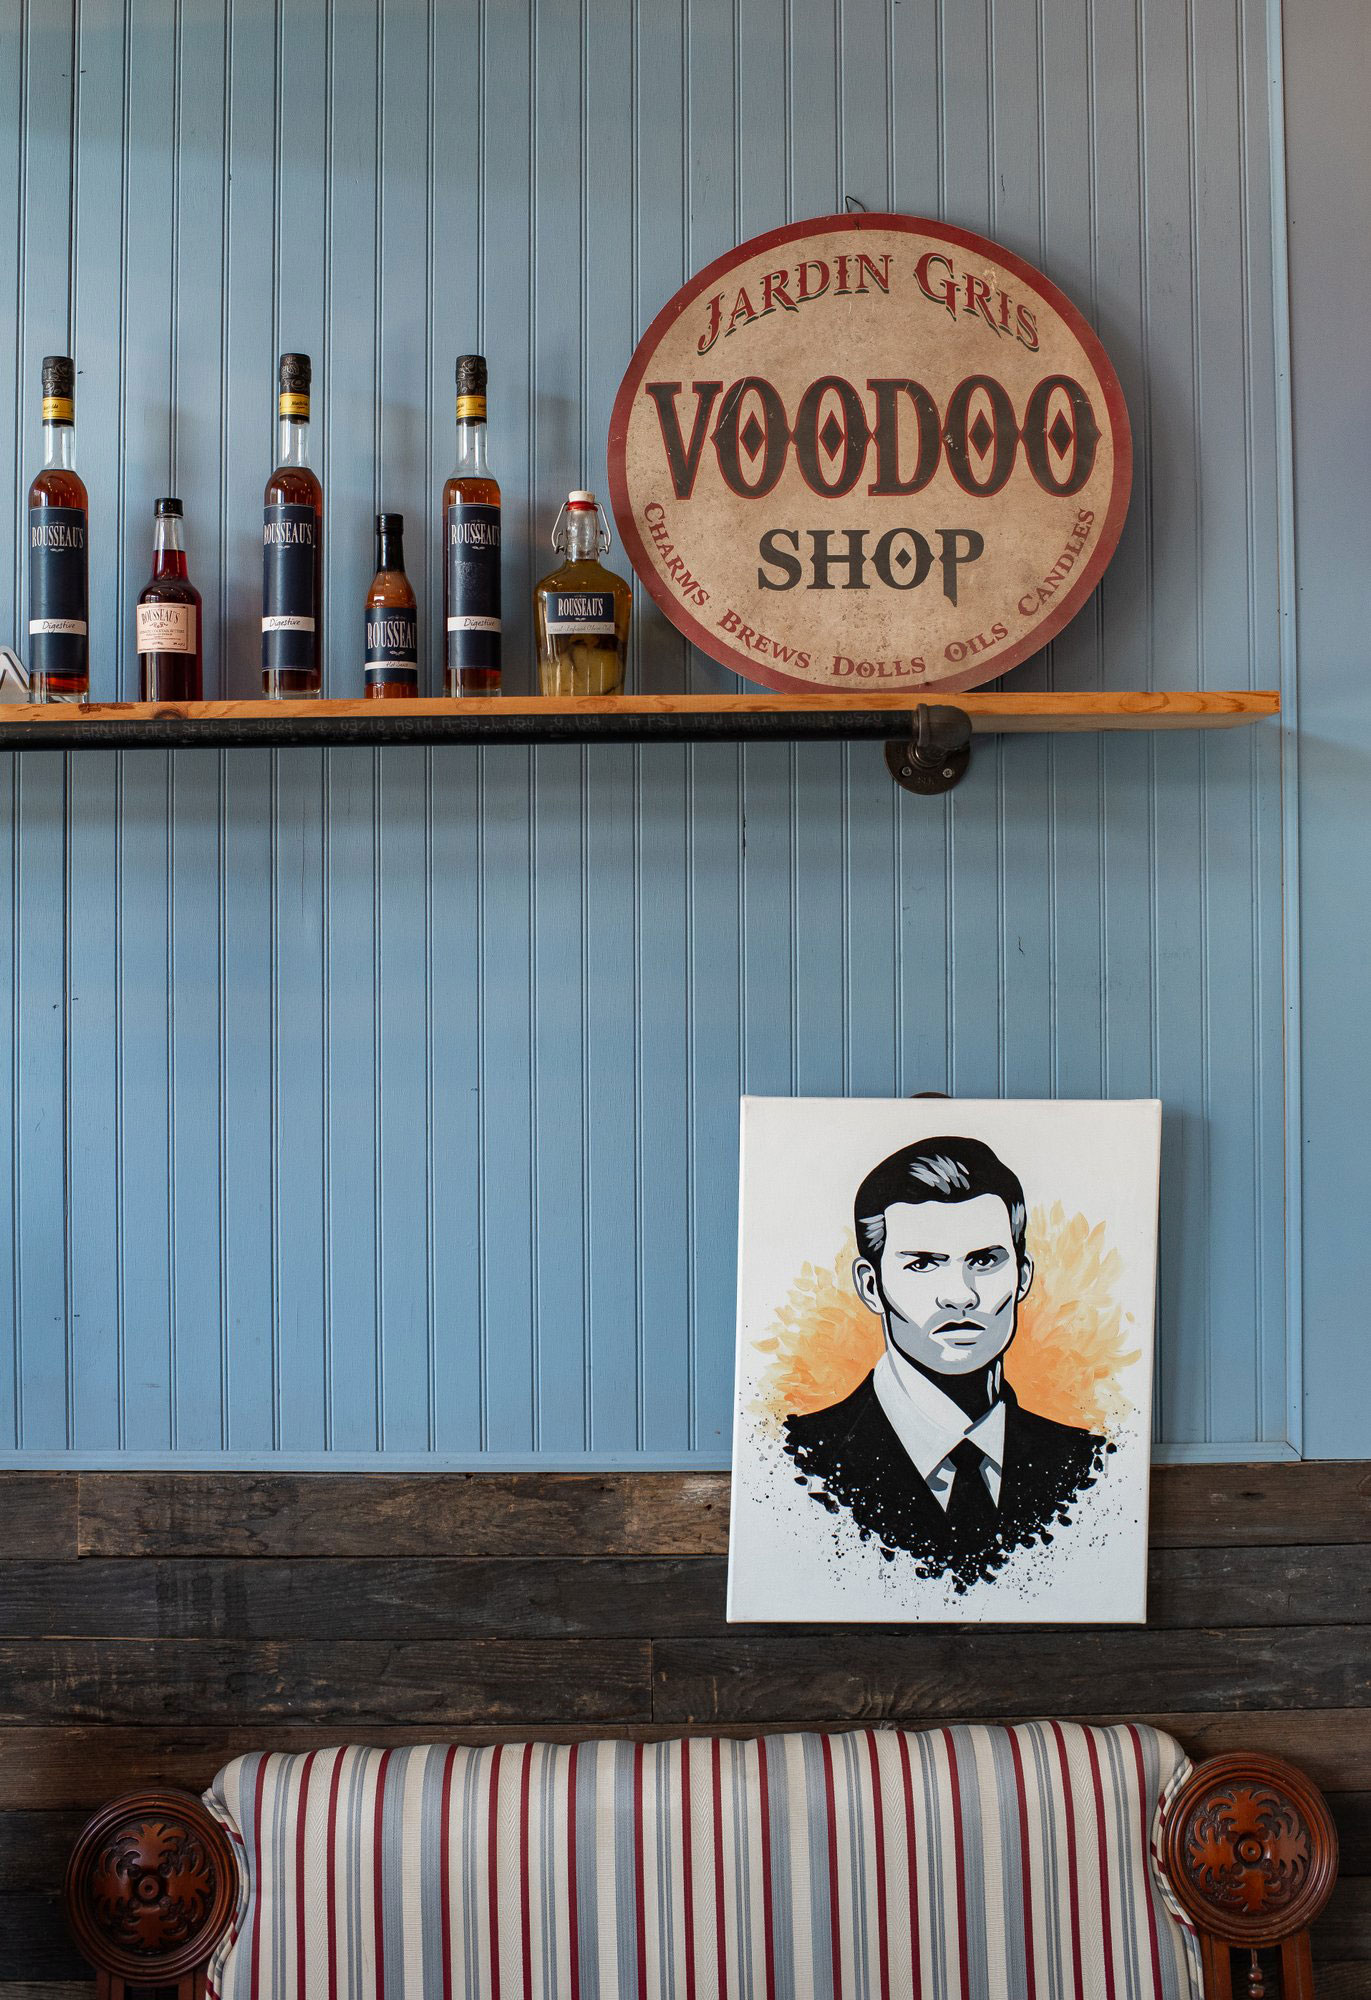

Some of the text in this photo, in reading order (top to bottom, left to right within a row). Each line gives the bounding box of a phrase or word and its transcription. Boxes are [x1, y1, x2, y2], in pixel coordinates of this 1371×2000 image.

[697, 252, 1041, 356] JARDIN GRIS
[645, 374, 1103, 500] VOODOO
[558, 598, 604, 617] ROUSSEAU'S
[643, 501, 1096, 679] CHARMS BREWS DOLLS OILS CANDLES
[757, 527, 986, 608] SHOP
[41, 620, 76, 634] Digestive
